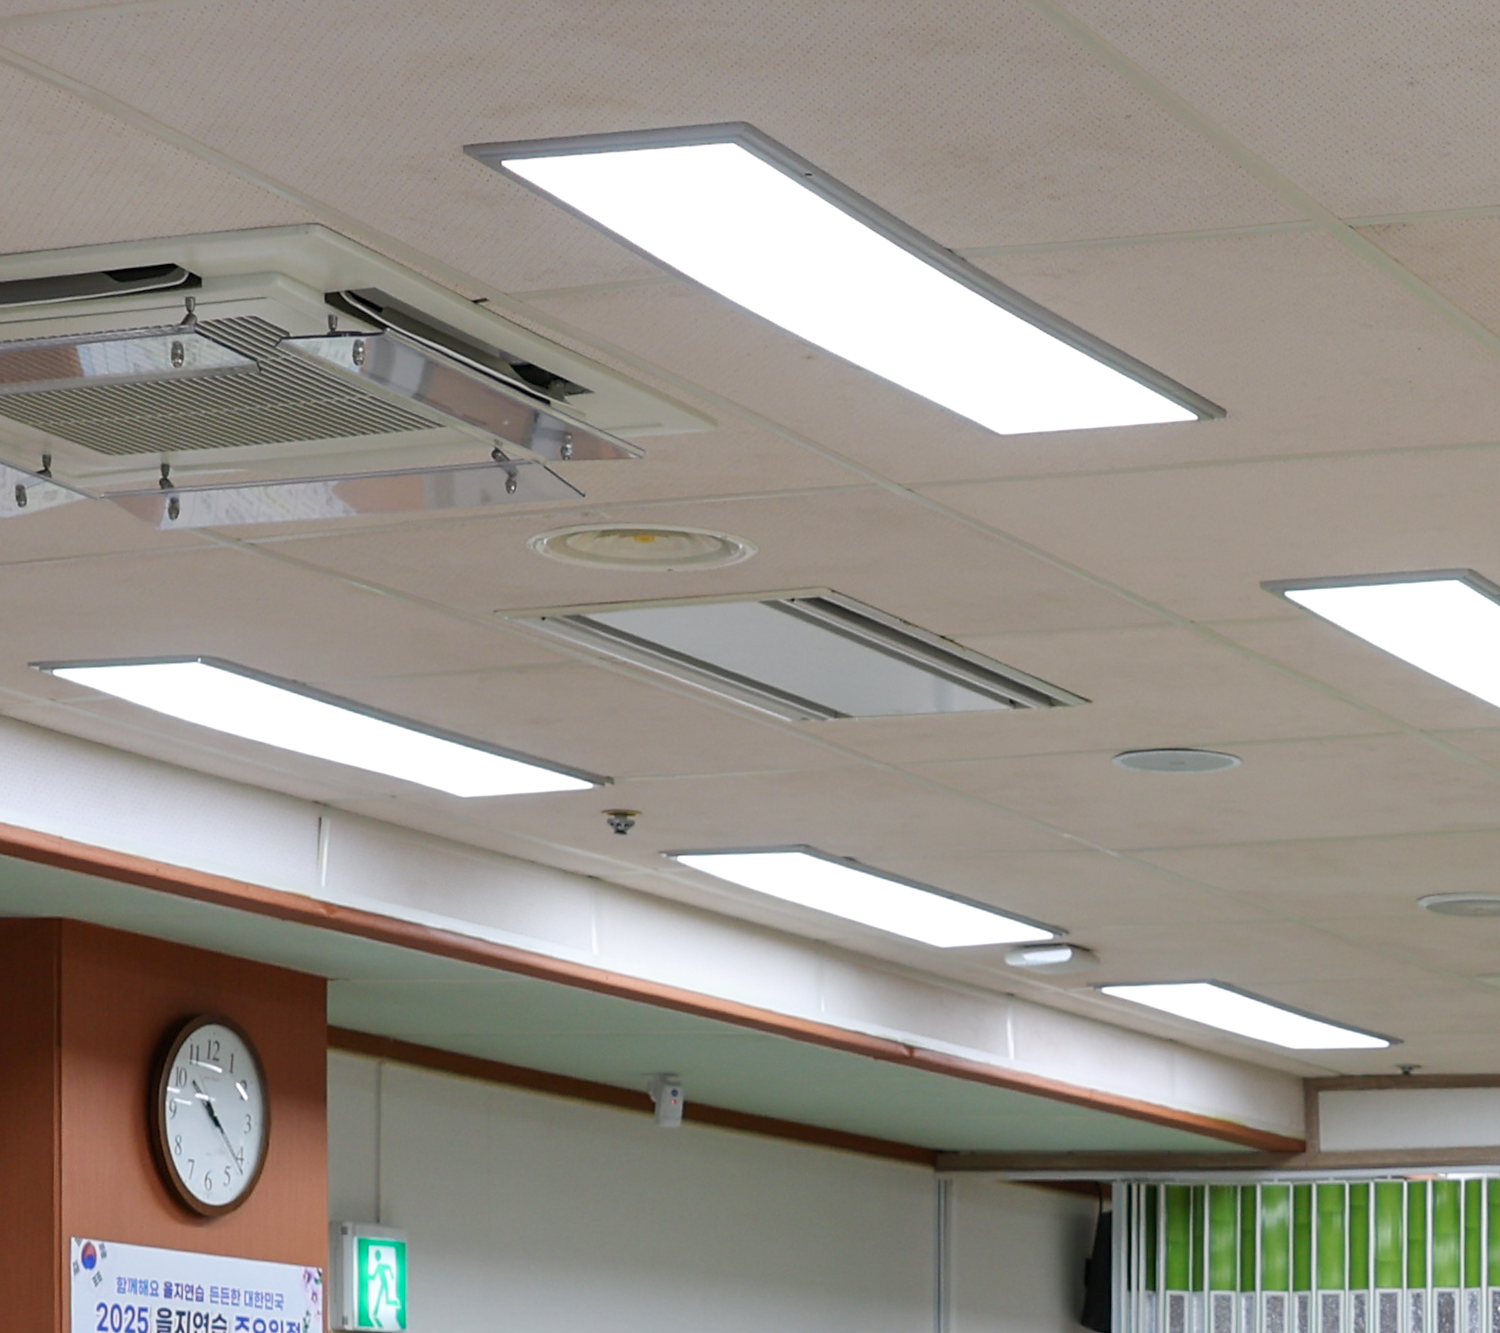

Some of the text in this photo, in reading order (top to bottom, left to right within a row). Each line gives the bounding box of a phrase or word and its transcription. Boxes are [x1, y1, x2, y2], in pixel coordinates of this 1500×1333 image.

[188, 1044, 200, 1067] 11
[206, 1039, 221, 1063] 12
[229, 1053, 235, 1074] 1
[175, 1066, 188, 1088] 10
[169, 1099, 177, 1119] 9
[244, 1114, 252, 1135] 3
[174, 1135, 182, 1156] 8
[236, 1146, 244, 1165] 4
[187, 1159, 195, 1179] 7
[223, 1166, 231, 1187] 5
[204, 1170, 213, 1191] 6
[116, 1276, 284, 1311] 함께해요 을지연습 든든한 대한민국
